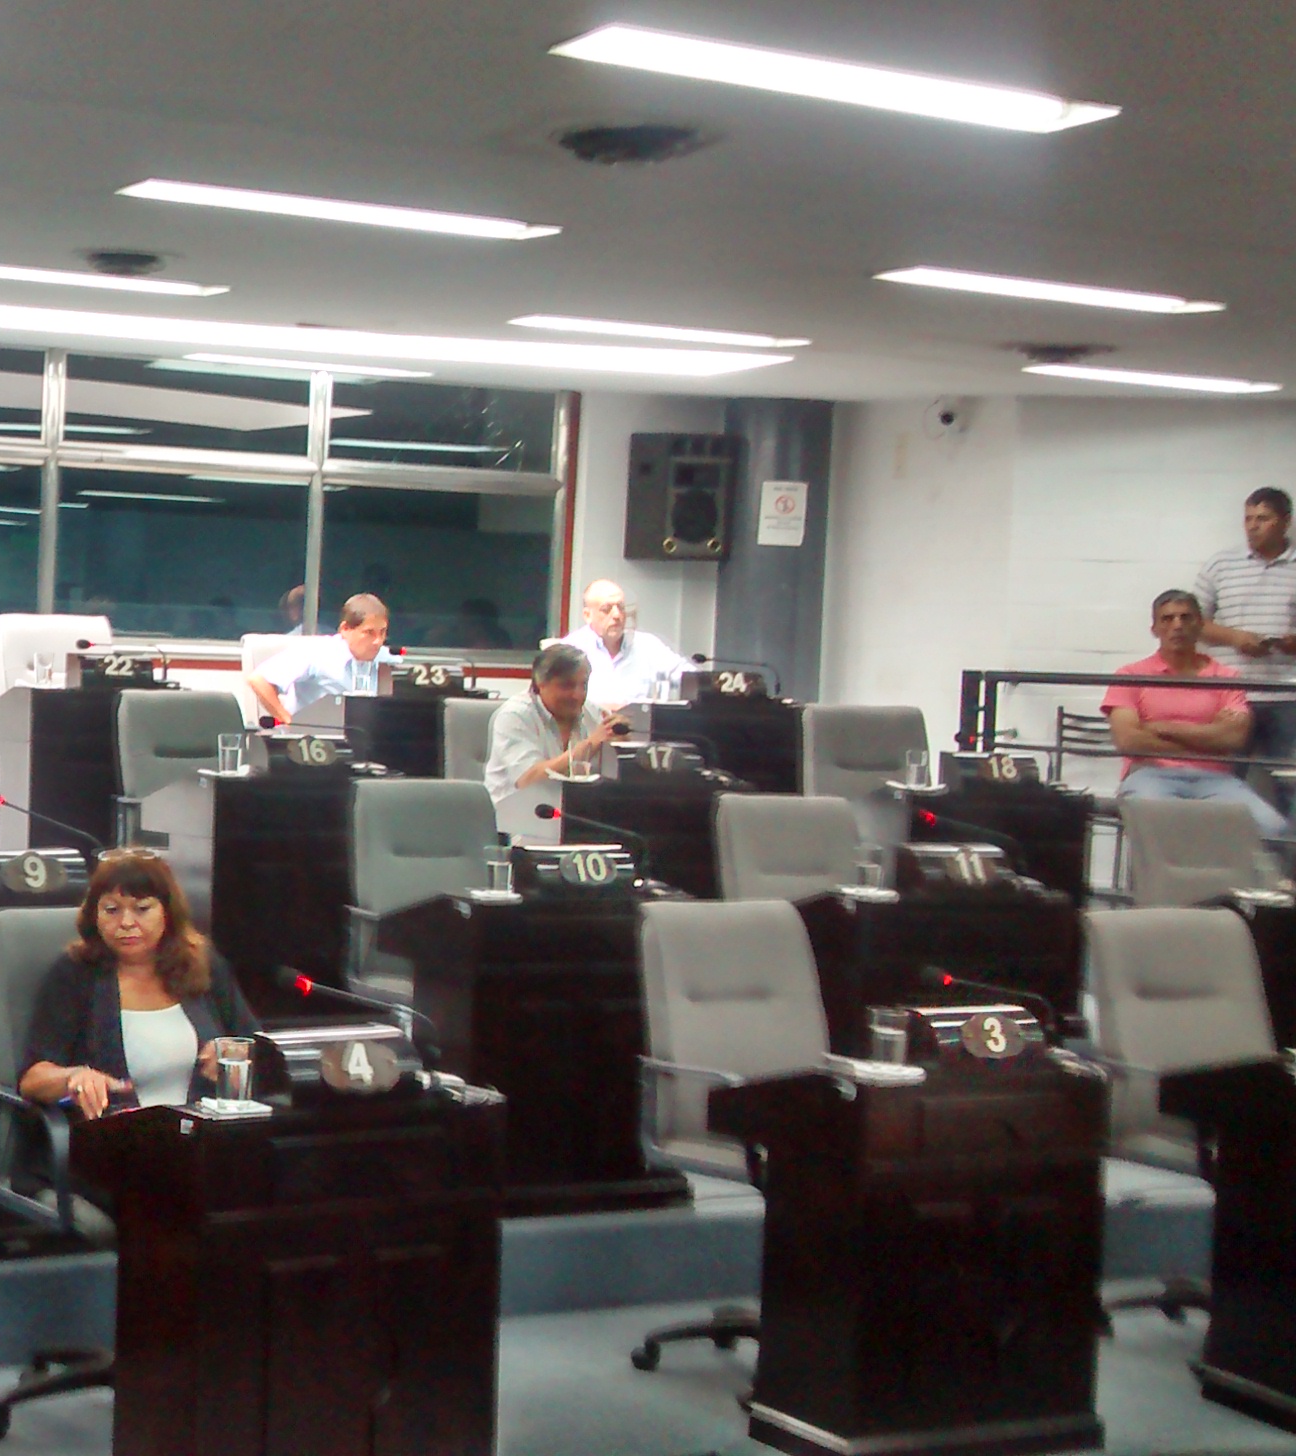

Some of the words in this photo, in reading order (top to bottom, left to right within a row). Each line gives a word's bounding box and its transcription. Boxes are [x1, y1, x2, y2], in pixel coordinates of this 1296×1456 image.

[104, 655, 134, 676] 22
[413, 664, 446, 686] 23
[718, 672, 746, 692] 24
[298, 739, 326, 762] 16
[647, 746, 673, 769] 17
[989, 757, 1017, 779] 18
[23, 856, 46, 888] 9
[573, 853, 607, 882] 10
[955, 853, 986, 884] 11
[984, 1017, 1007, 1052] 3
[348, 1043, 373, 1084] 4
